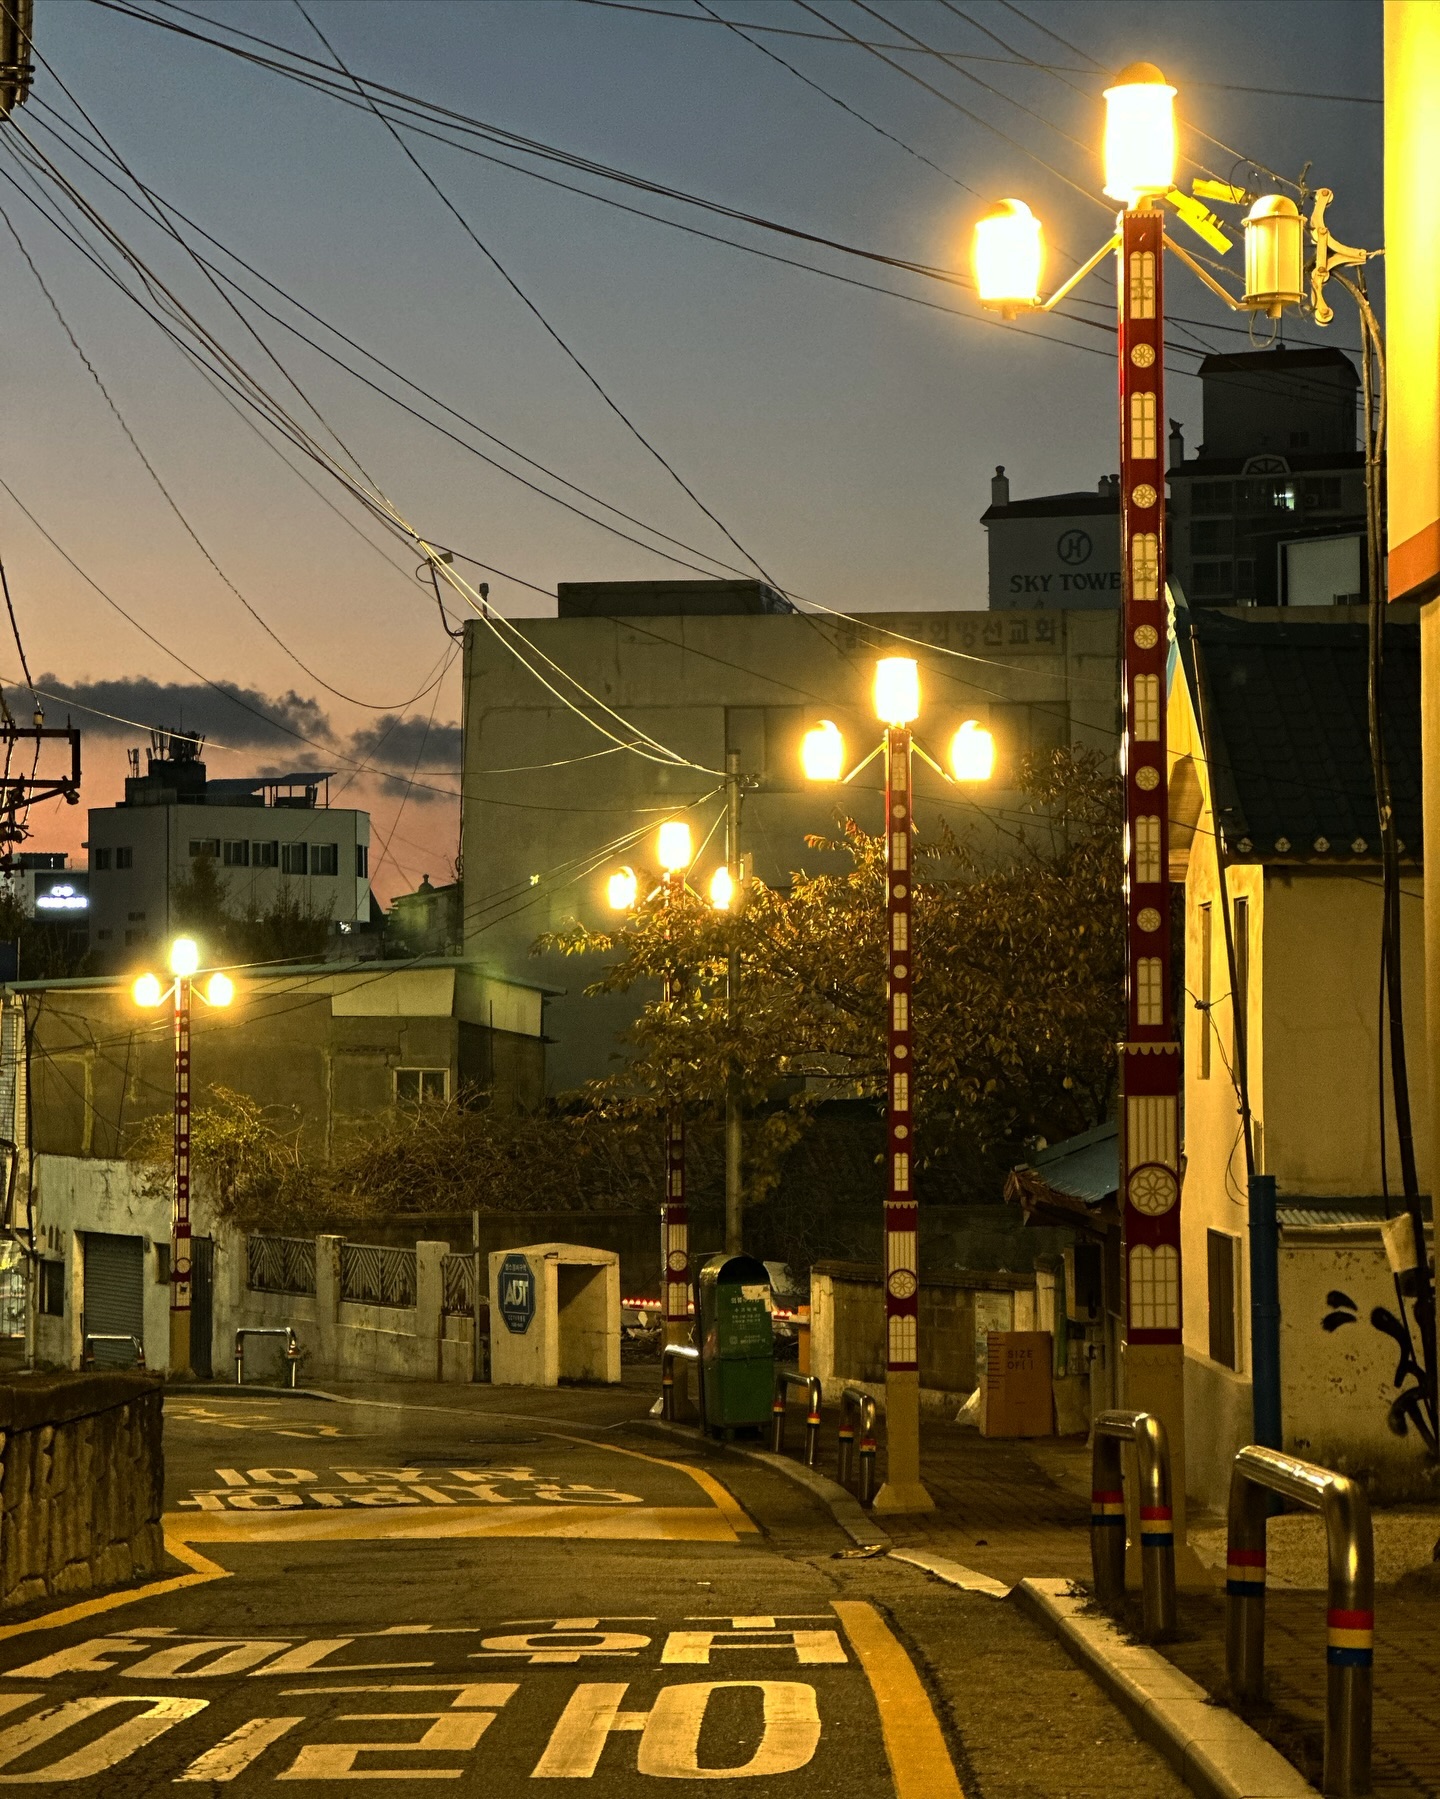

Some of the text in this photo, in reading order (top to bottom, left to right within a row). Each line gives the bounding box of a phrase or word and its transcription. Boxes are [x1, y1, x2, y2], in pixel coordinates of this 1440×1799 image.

[1010, 572, 1121, 593] SKY TOWE
[504, 1280, 529, 1307] ADT
[1007, 1349, 1033, 1359] SIZE
[214, 1466, 561, 1486] 천천히
[178, 1484, 645, 1511] 유치원앞
[1, 1615, 849, 1679] 보호구역
